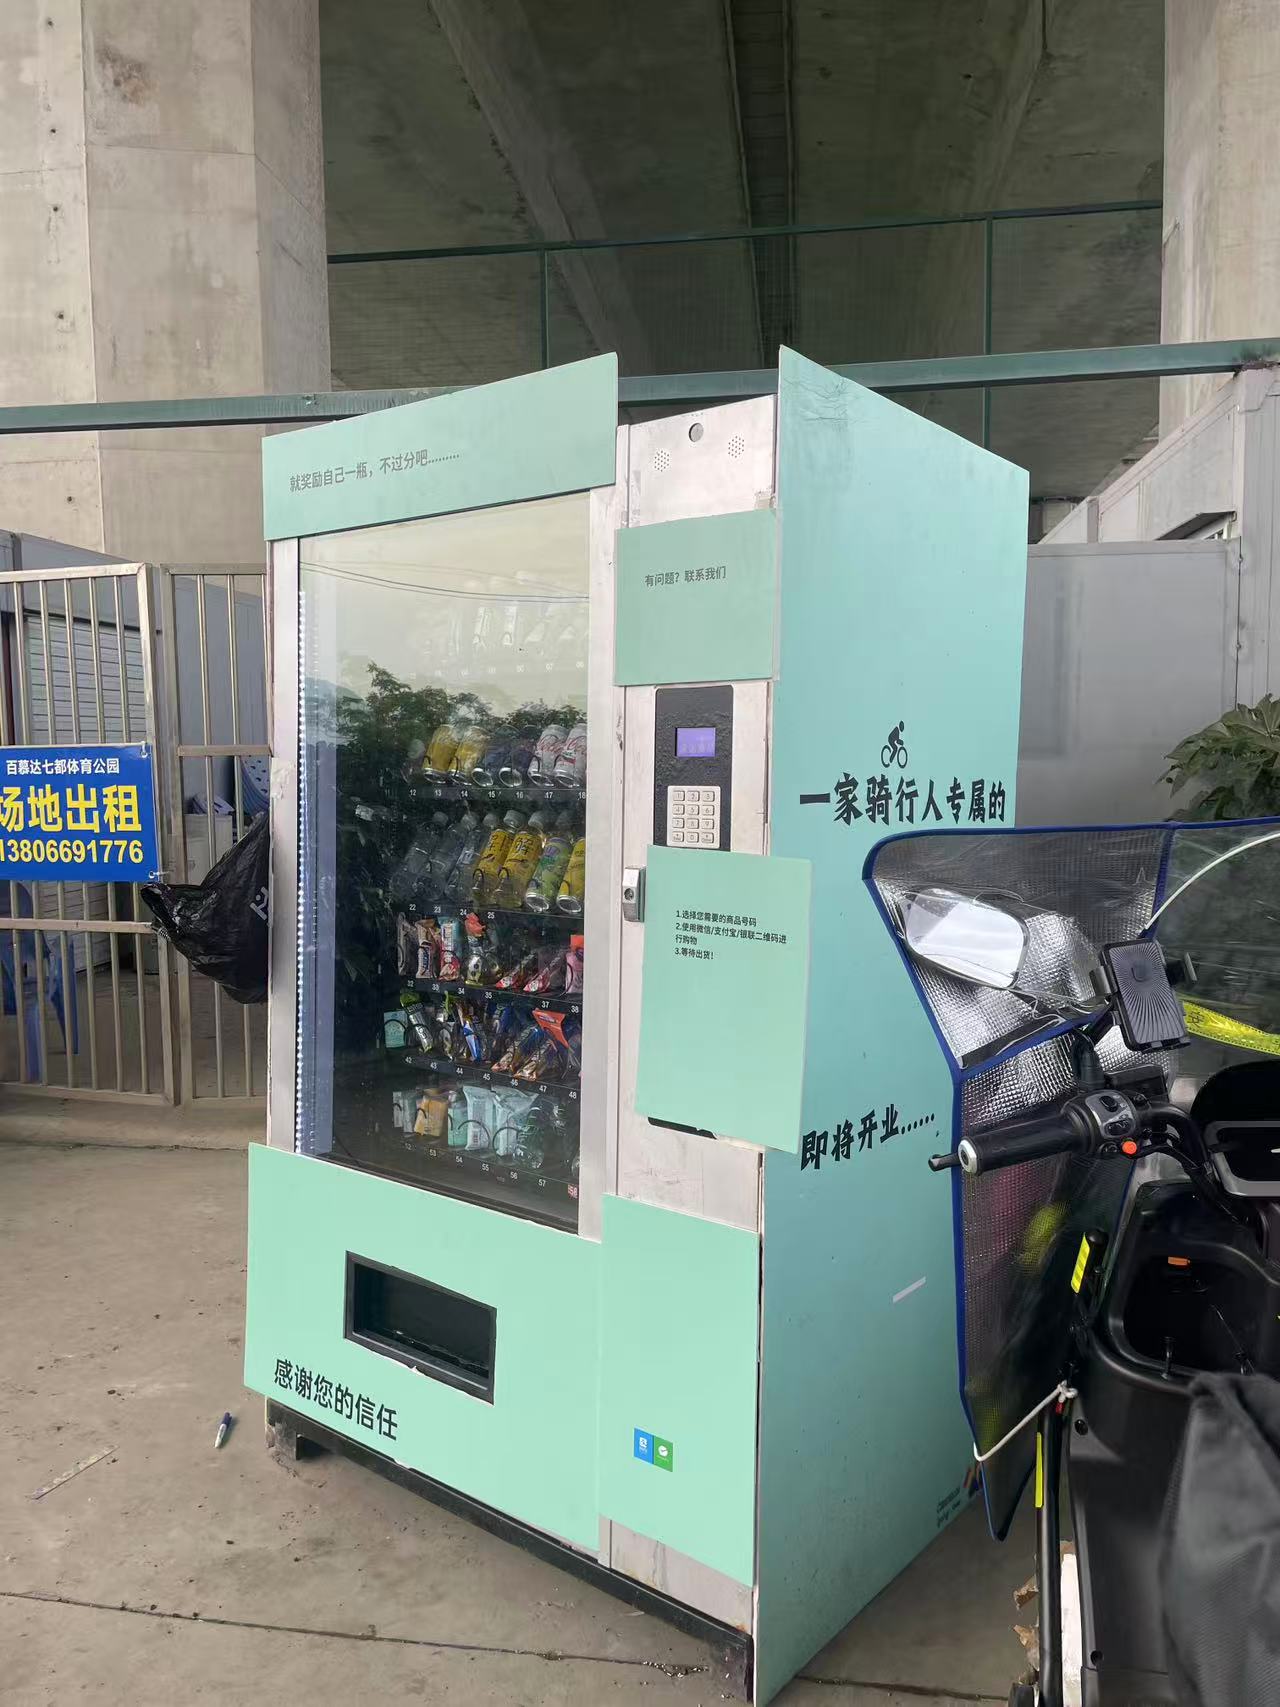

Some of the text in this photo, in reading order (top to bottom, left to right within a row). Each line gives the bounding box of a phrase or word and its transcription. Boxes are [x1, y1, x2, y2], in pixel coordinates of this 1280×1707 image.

[644, 565, 727, 587] 有问题？联系我们
[6, 758, 120, 775] 百慕达七都体育公园
[409, 788, 417, 796] 12
[434, 789, 442, 797] 13
[545, 791, 554, 799] 17
[800, 772, 1006, 825] 一家骑行人专属的
[0, 783, 142, 834] 场地出租
[409, 903, 495, 920] 22 23 24 25
[676, 910, 757, 927] 1.选择您需要的商品号码
[675, 922, 787, 944] 2.使用微信/支付宝/银联二维码进
[675, 934, 698, 945] 行购物
[407, 980, 415, 988] 32
[457, 987, 466, 995] 34
[484, 991, 493, 999] 35
[541, 1000, 550, 1009] 37
[405, 1056, 413, 1064] 42
[430, 1061, 437, 1070] 43
[456, 1067, 464, 1075] 44
[482, 1073, 491, 1081] 45
[539, 1085, 548, 1093] 47
[568, 1091, 577, 1100] 48
[455, 1155, 463, 1163] 54
[481, 1163, 490, 1172] 55
[538, 1178, 547, 1187] 57
[275, 1359, 397, 1441] 感谢您的信任
